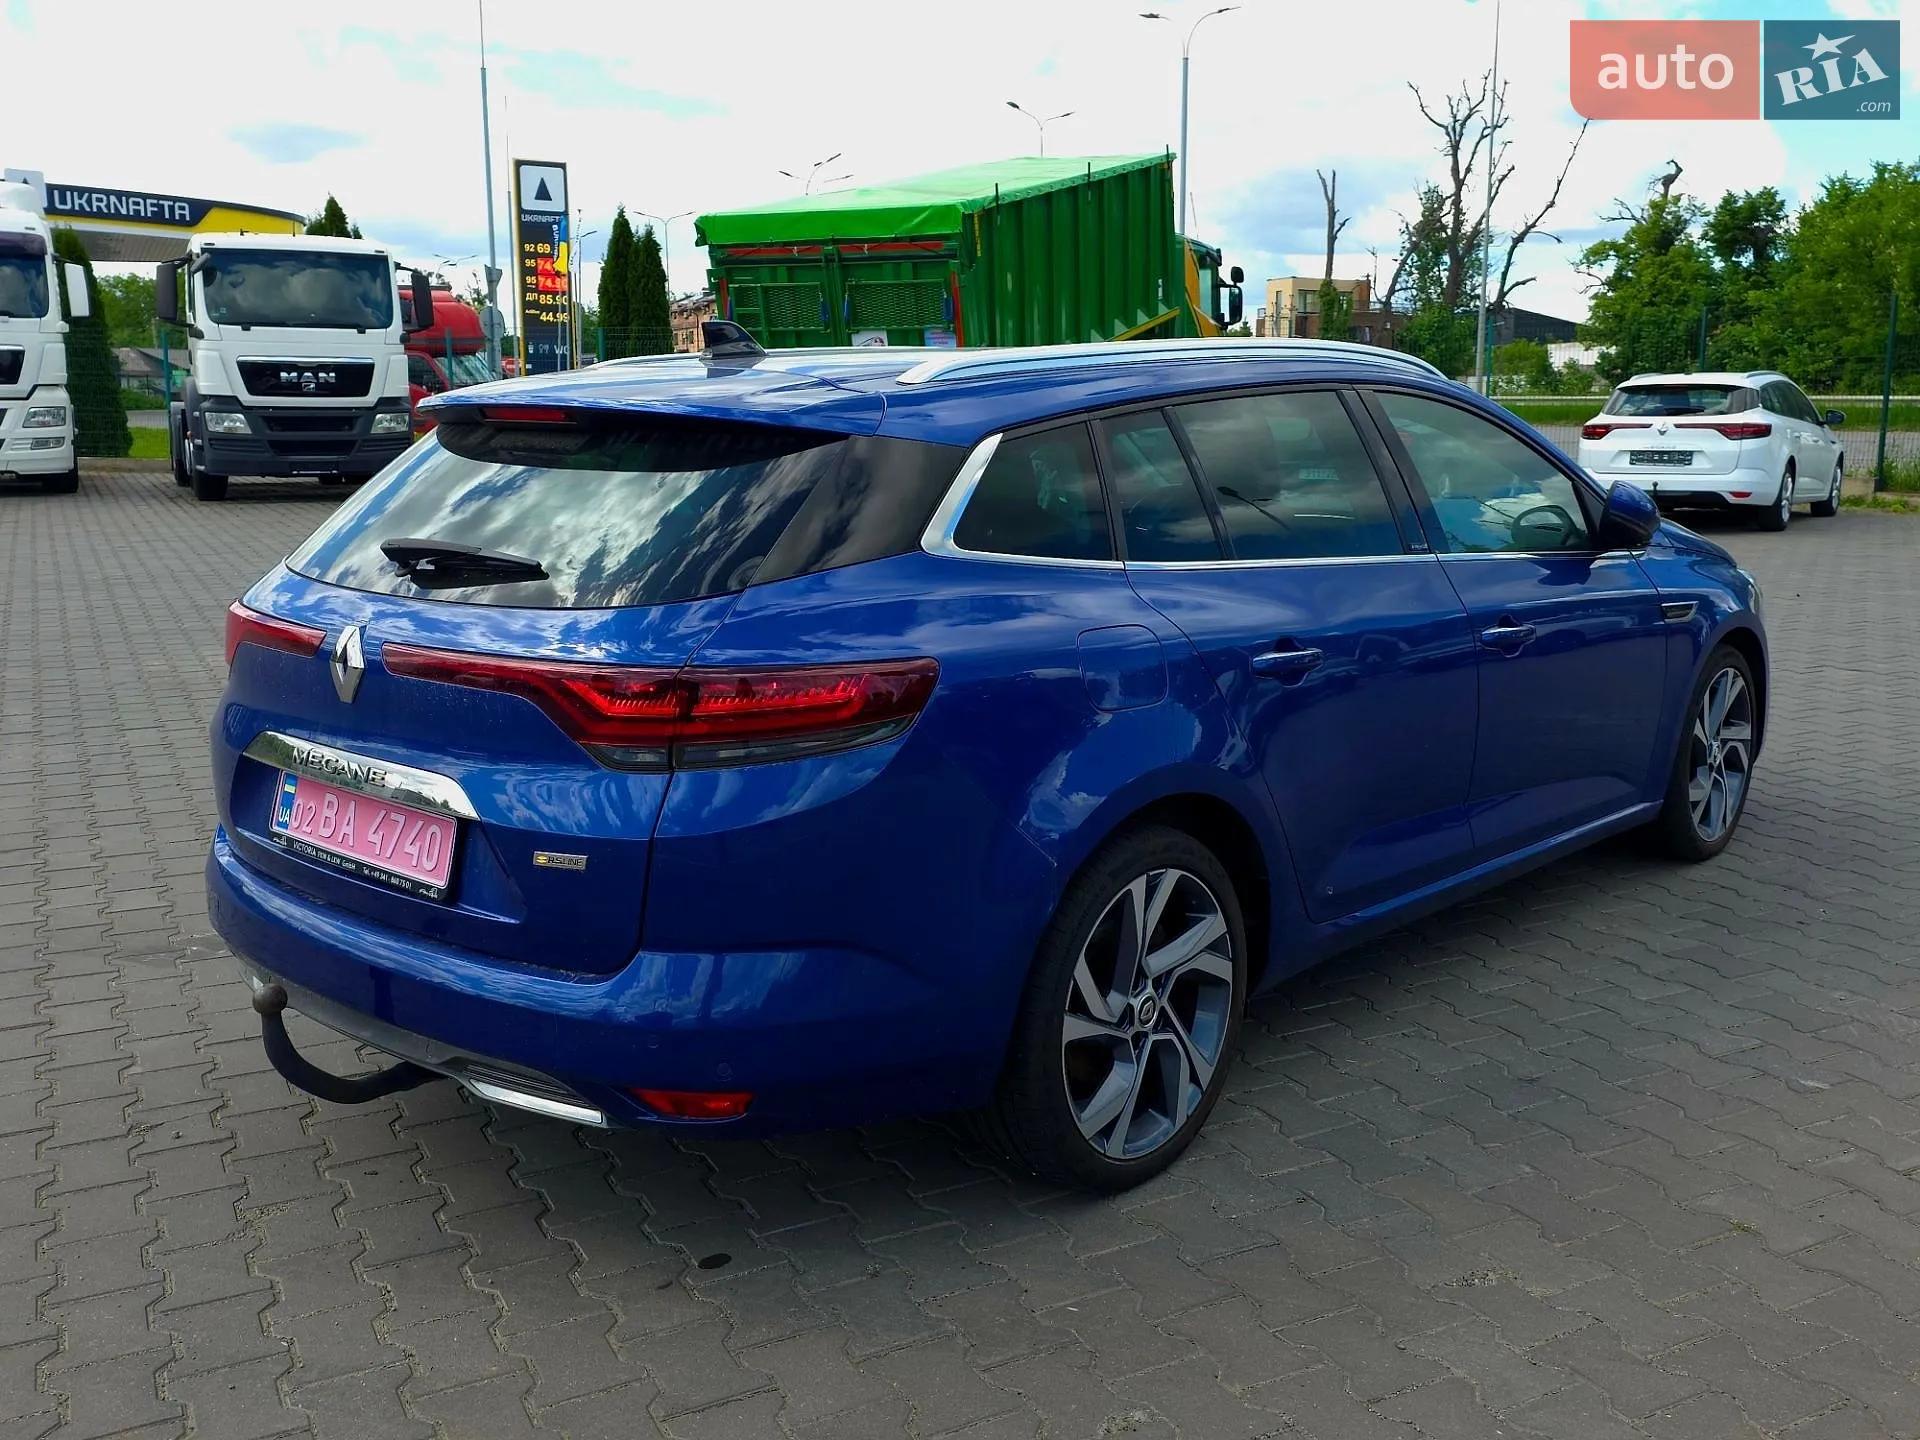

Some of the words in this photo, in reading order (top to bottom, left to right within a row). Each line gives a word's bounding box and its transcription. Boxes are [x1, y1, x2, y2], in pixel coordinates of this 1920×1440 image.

[53, 189, 190, 222] UKRNAFTA
[524, 243, 535, 252] 92
[525, 258, 536, 267] 95
[525, 275, 537, 284] 95
[280, 372, 336, 383] MAN
[292, 746, 388, 788] MEGANE
[278, 806, 290, 824] UA
[293, 840, 317, 856] VICTORIA
[367, 809, 442, 873] 4740
